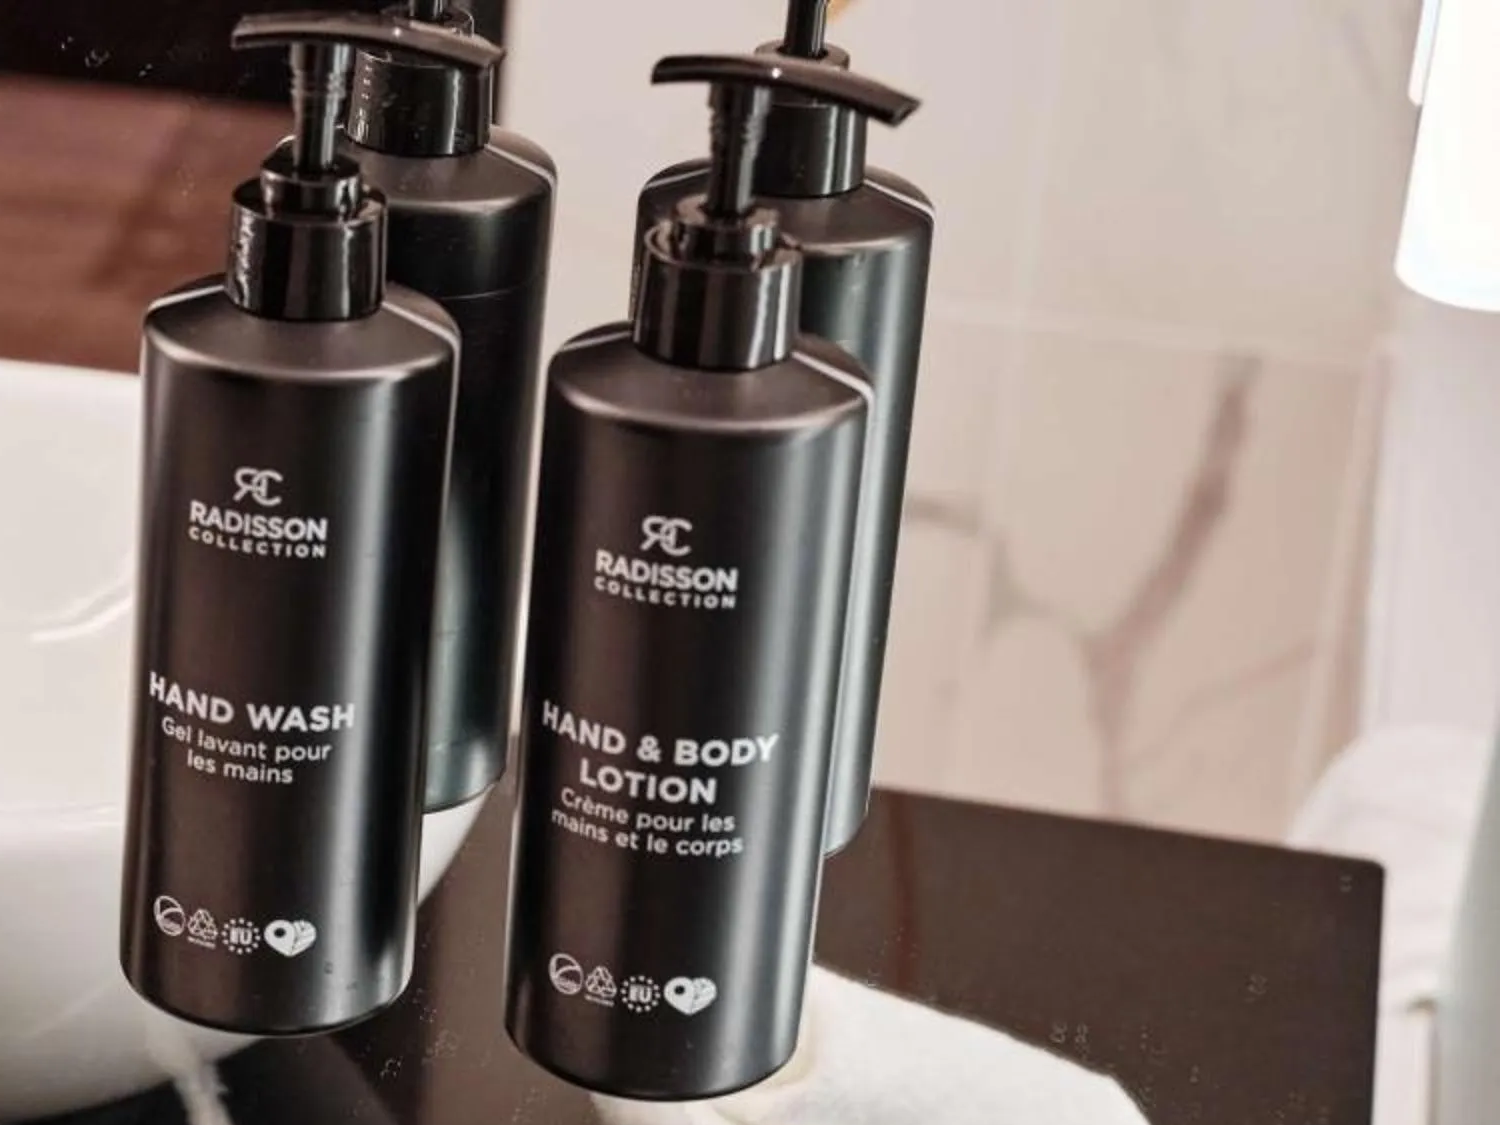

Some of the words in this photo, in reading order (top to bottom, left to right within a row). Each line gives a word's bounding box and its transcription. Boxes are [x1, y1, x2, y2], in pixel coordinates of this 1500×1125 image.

[188, 527, 326, 558] COLLECTION
[189, 500, 327, 542] RADISSON
[595, 549, 737, 593] RADISSON
[595, 575, 736, 609] COLLECTION
[149, 671, 235, 725] HAND
[245, 702, 355, 732] WASH
[161, 715, 192, 745] Gel
[197, 729, 268, 758] lavant
[274, 740, 331, 767] pour
[542, 700, 626, 756] HAND
[636, 735, 662, 763] &
[673, 733, 779, 767] BODY
[186, 748, 217, 774] les
[222, 757, 293, 784] mains
[579, 759, 717, 805] LOTION
[551, 807, 609, 842] mains
[614, 824, 641, 849] et
[645, 829, 669, 853] le
[674, 834, 744, 858] corps
[560, 787, 630, 824] Crème
[636, 807, 695, 837] pour
[702, 810, 736, 834] les
